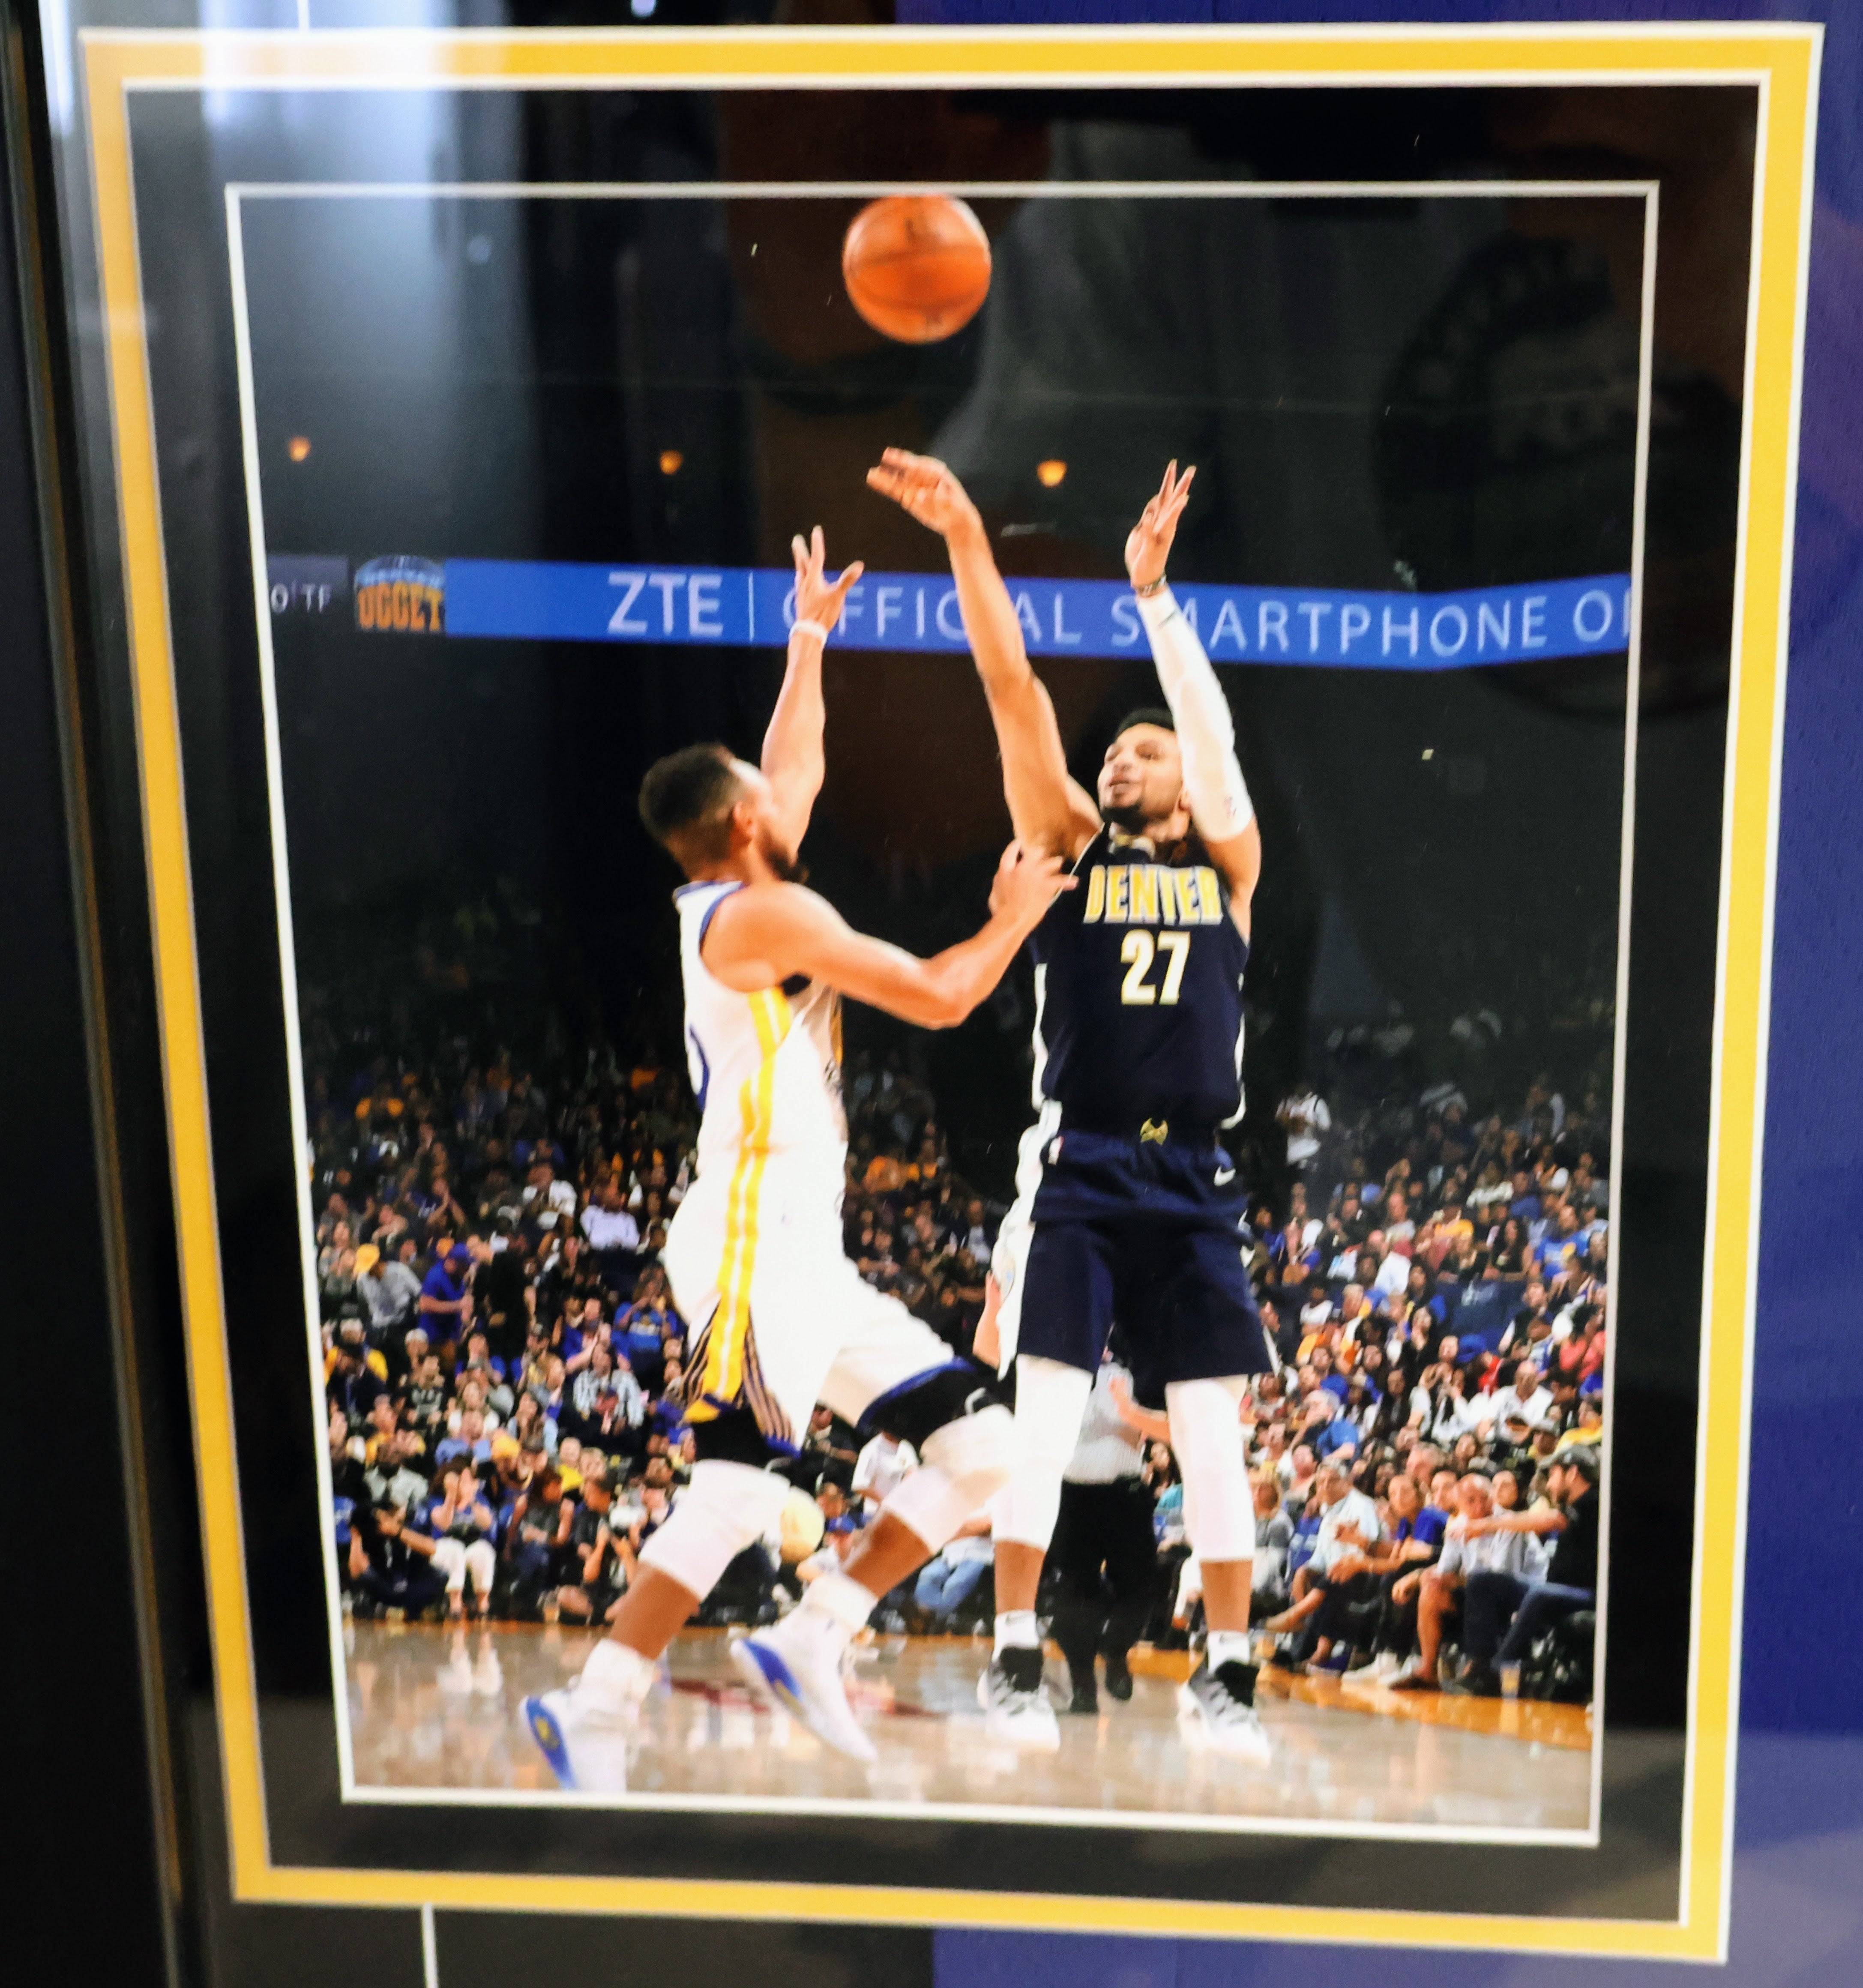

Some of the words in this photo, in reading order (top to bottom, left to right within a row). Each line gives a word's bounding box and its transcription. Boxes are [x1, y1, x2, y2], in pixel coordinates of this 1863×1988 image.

[607, 572, 724, 638] ZTE
[783, 584, 1082, 645] FFICAL
[1573, 584, 1632, 642] O
[1083, 863, 1224, 925] DENVER
[1120, 928, 1191, 1006] 27
